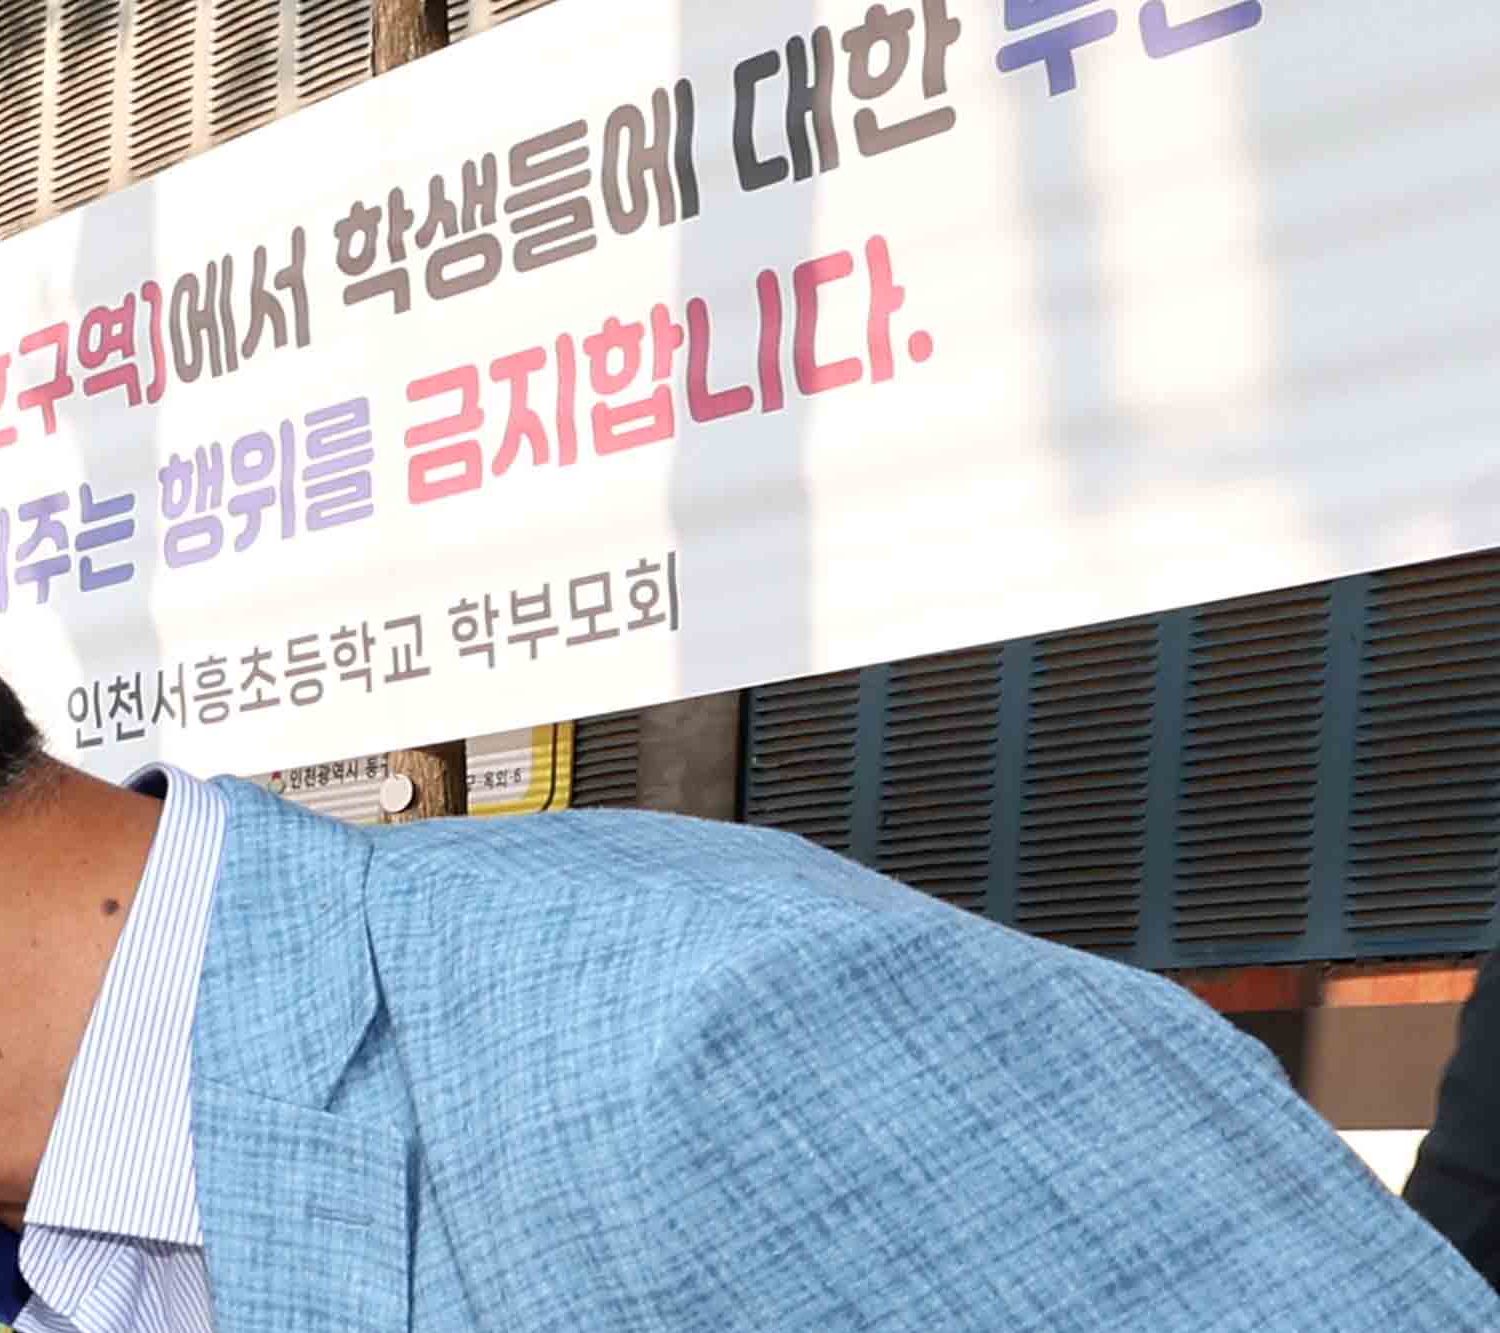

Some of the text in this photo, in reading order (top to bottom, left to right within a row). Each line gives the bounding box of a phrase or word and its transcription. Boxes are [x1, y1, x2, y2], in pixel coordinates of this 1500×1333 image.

[332, 78, 702, 313] 학생들에
[732, 2, 961, 192] 대한
[159, 396, 375, 569] 행위를
[402, 233, 935, 506] 금지합니다.
[67, 550, 682, 750] 인천서흥초등학교 학부모회
[289, 757, 360, 792] 인천광역시
